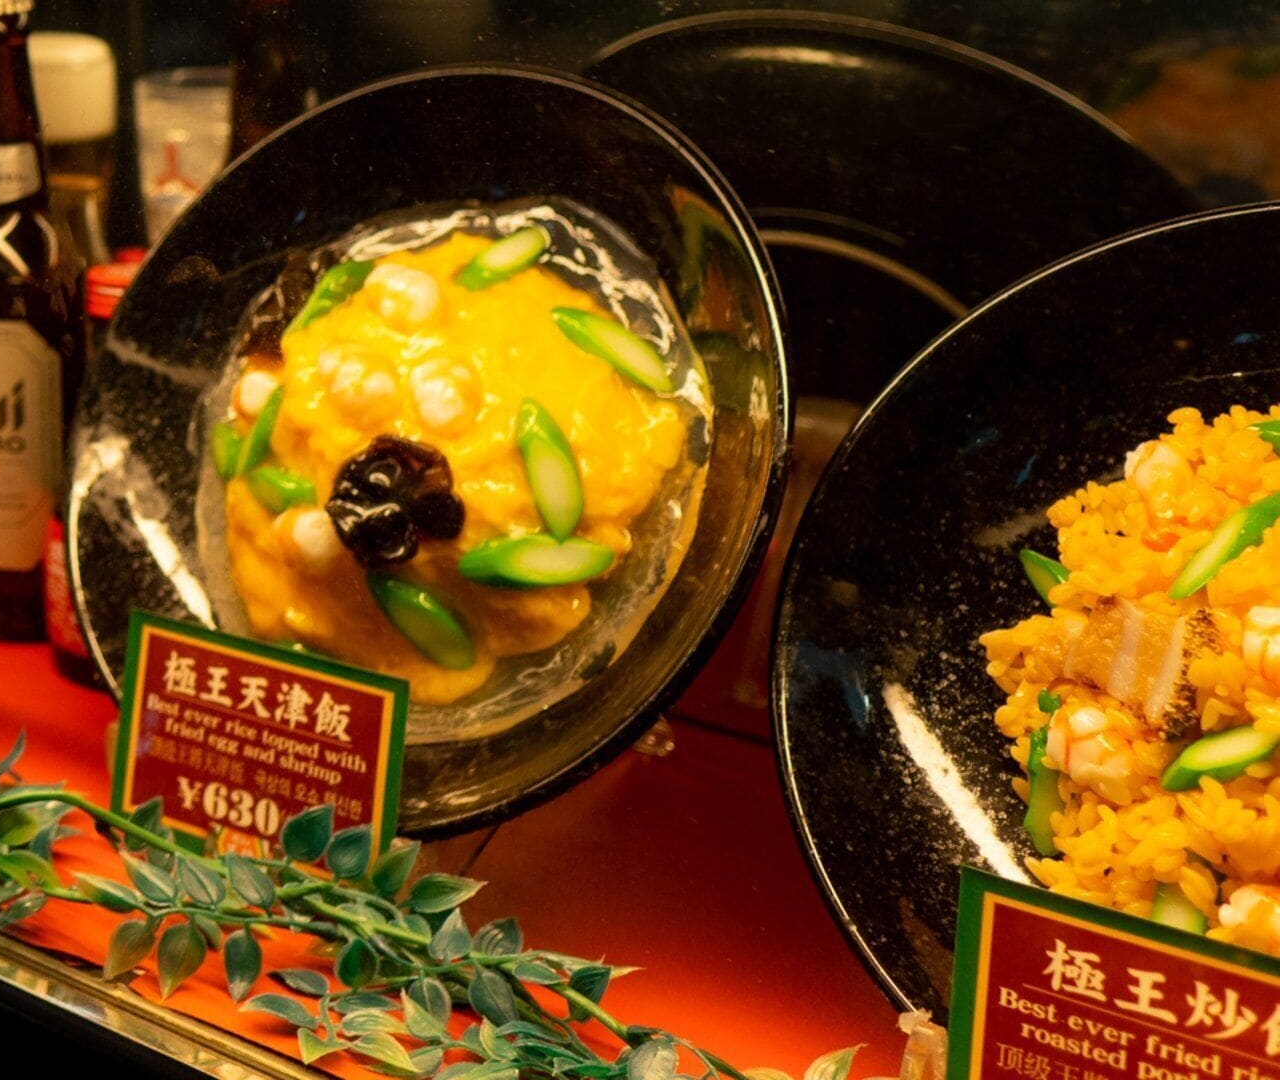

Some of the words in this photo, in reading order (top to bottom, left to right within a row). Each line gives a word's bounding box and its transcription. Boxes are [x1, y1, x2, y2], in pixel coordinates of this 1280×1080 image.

[146, 692, 179, 718] Best
[183, 706, 223, 729] ever
[224, 713, 259, 741] rice
[261, 726, 320, 761] topped
[324, 746, 368, 774] with
[162, 649, 352, 743] 極王天津飯
[164, 718, 206, 744] fried
[208, 733, 240, 756] egg
[242, 739, 277, 767] and
[279, 749, 343, 787] shrimp
[176, 775, 281, 837] ¥630
[997, 985, 1059, 1025] Best
[1066, 1011, 1137, 1049] ever
[1145, 1034, 1222, 1077] fried
[1042, 937, 1280, 1058] 極王炒
[1019, 1021, 1129, 1071] roasted
